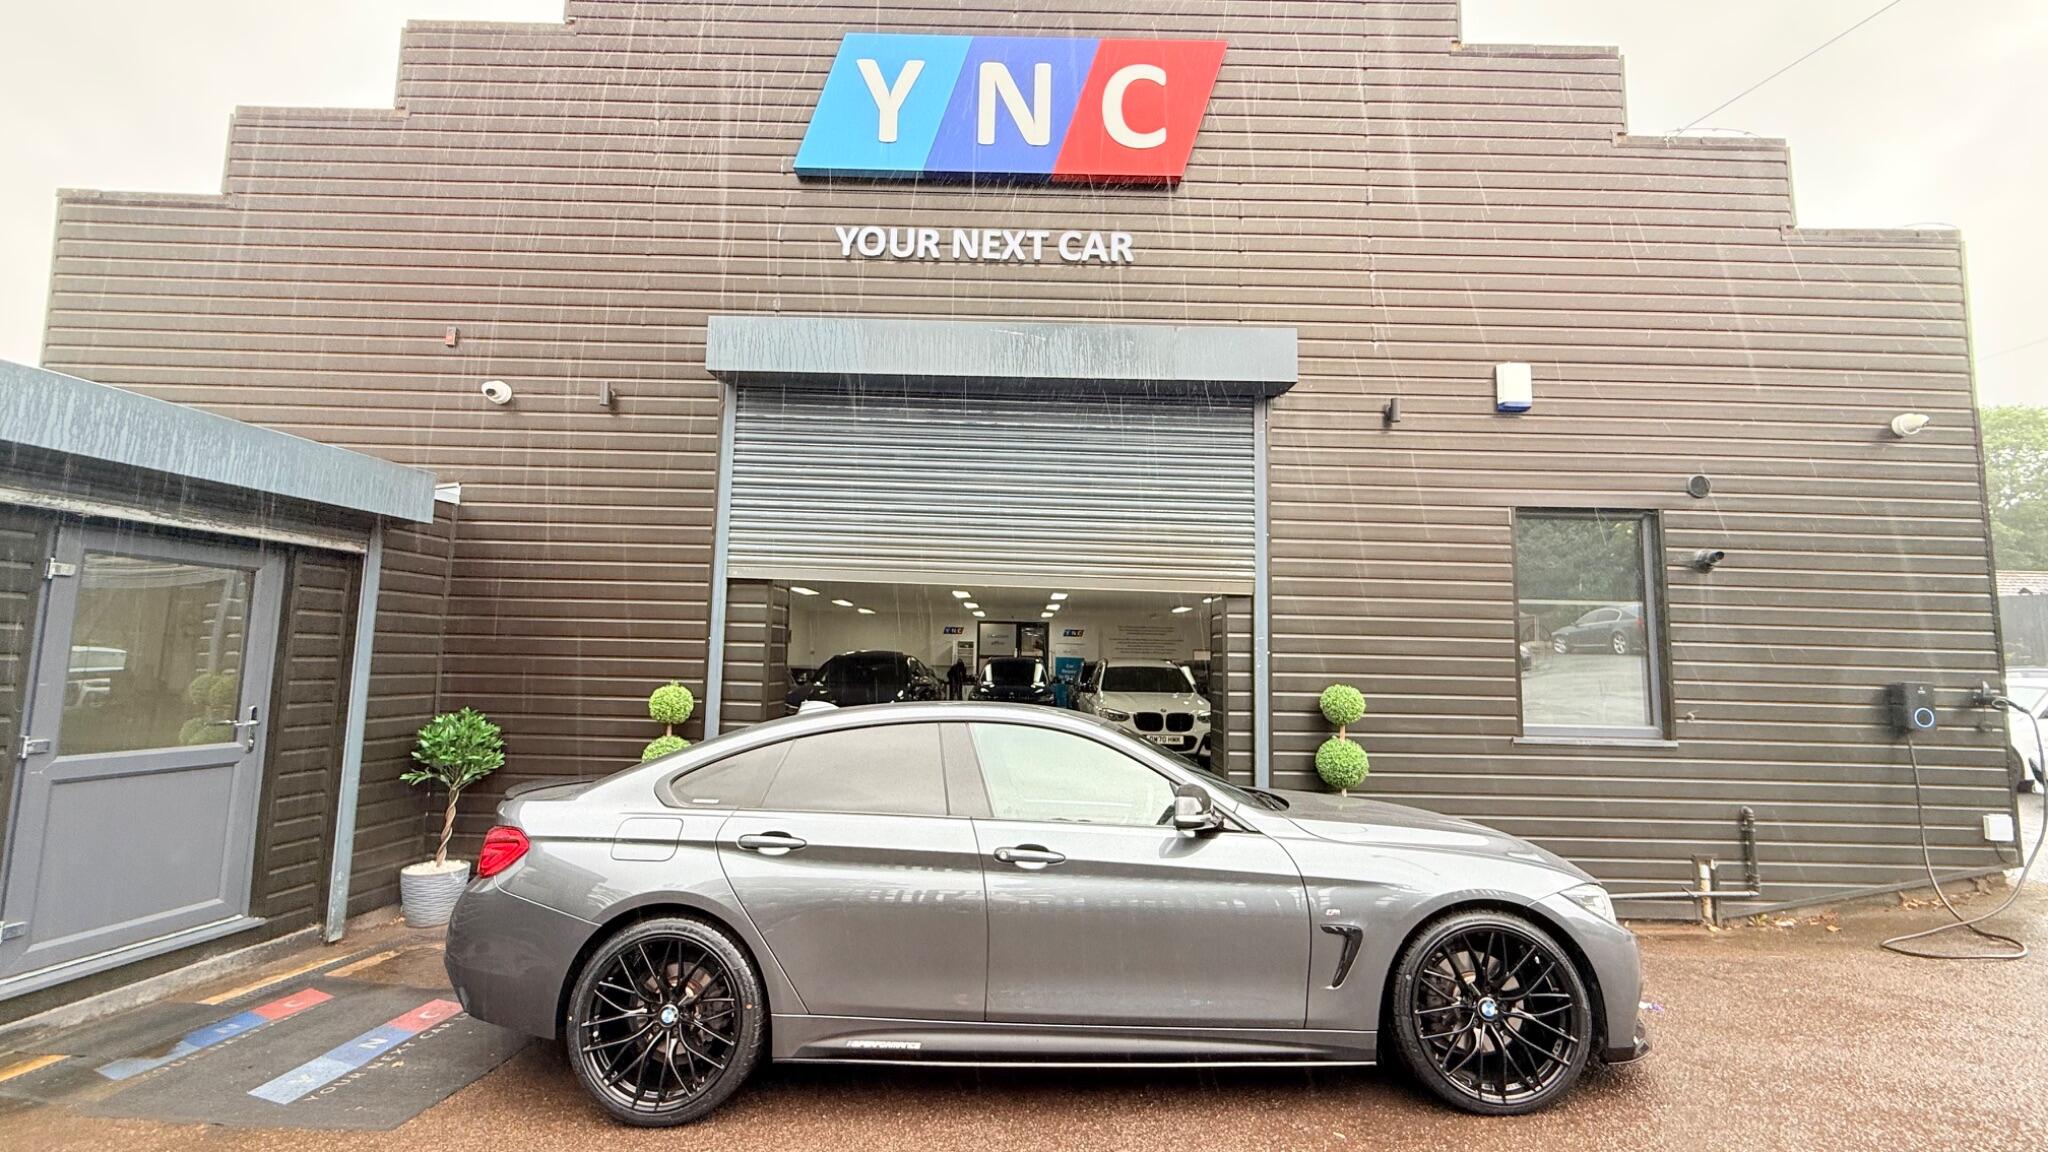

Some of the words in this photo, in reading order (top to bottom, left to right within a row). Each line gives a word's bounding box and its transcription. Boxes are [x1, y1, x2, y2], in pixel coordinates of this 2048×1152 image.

[856, 59, 1167, 149] YNC
[835, 227, 941, 260] YOUR
[952, 229, 1048, 261] NEXT
[1058, 230, 1134, 263] CAR
[303, 1071, 367, 1102] YOUR
[368, 1041, 415, 1070] NEXT
[419, 1021, 453, 1039] CAR
